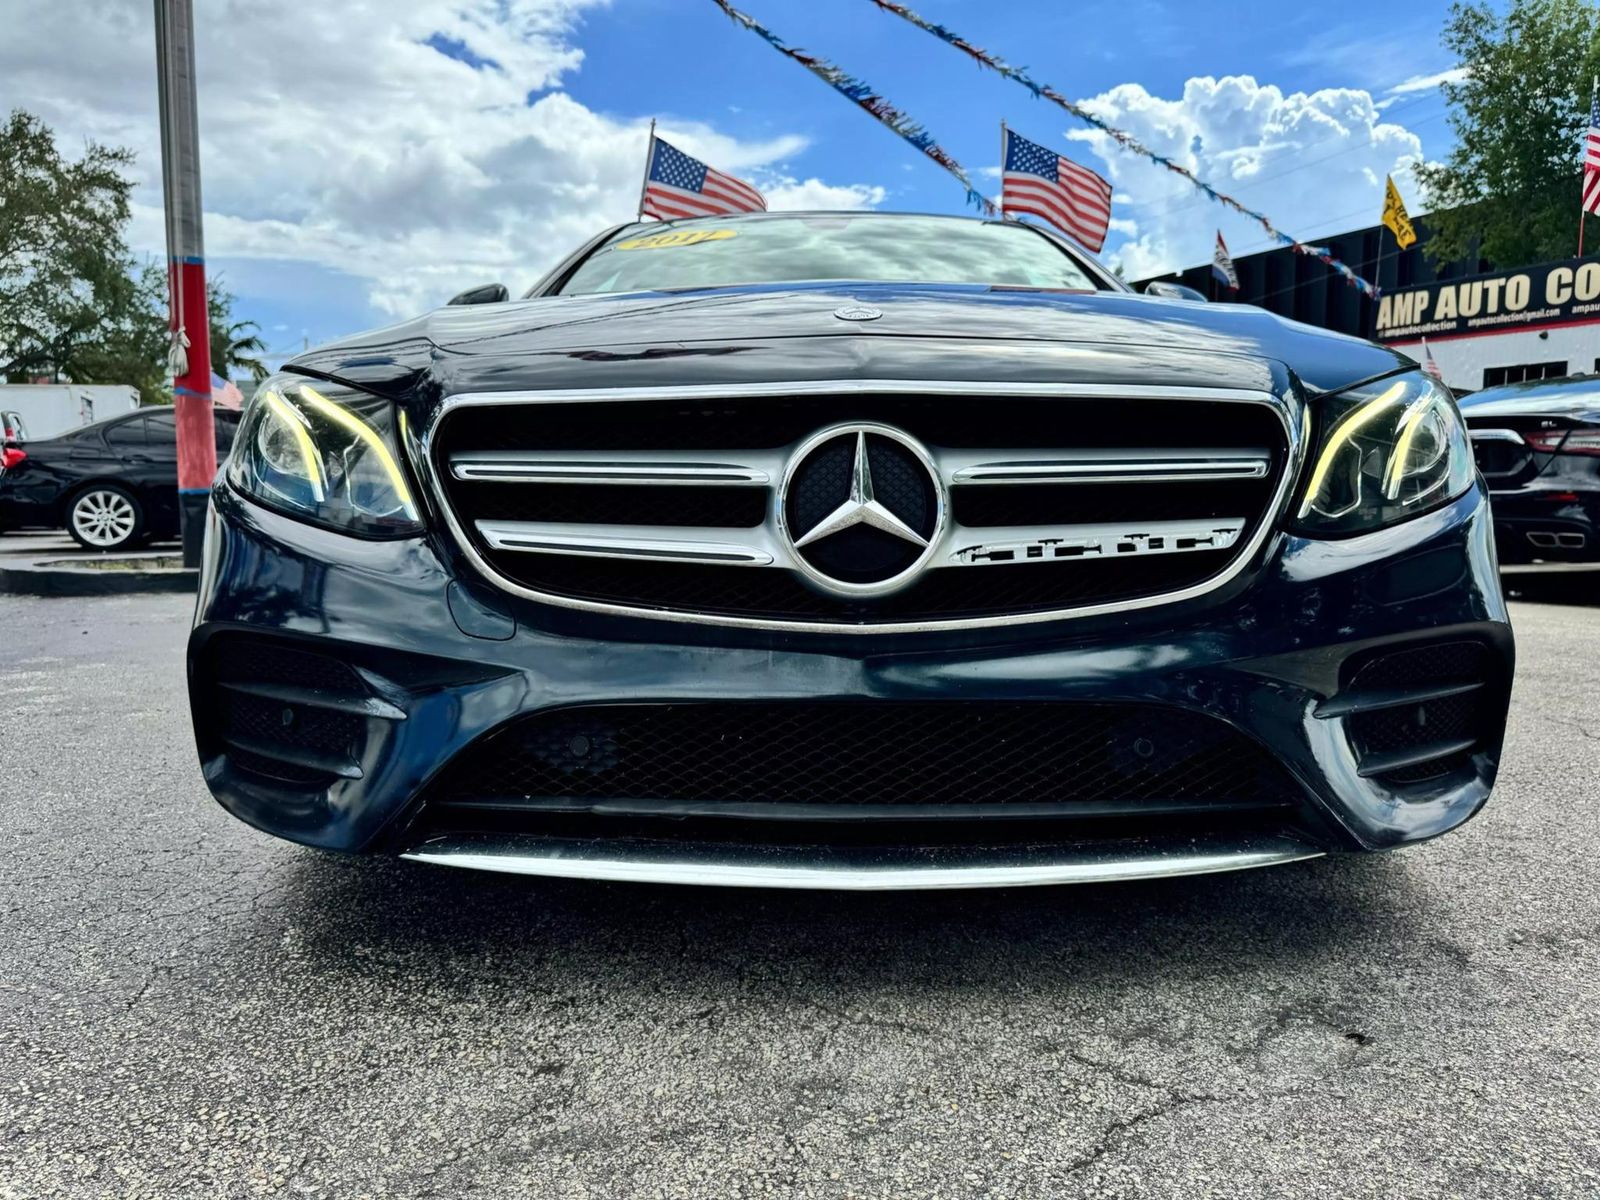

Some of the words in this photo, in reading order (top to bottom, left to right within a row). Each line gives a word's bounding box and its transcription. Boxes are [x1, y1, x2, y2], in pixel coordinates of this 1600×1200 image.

[633, 230, 718, 248] 2017
[1376, 290, 1429, 330] AMP
[1434, 274, 1531, 320] AUTO
[1545, 262, 1600, 305] CO
